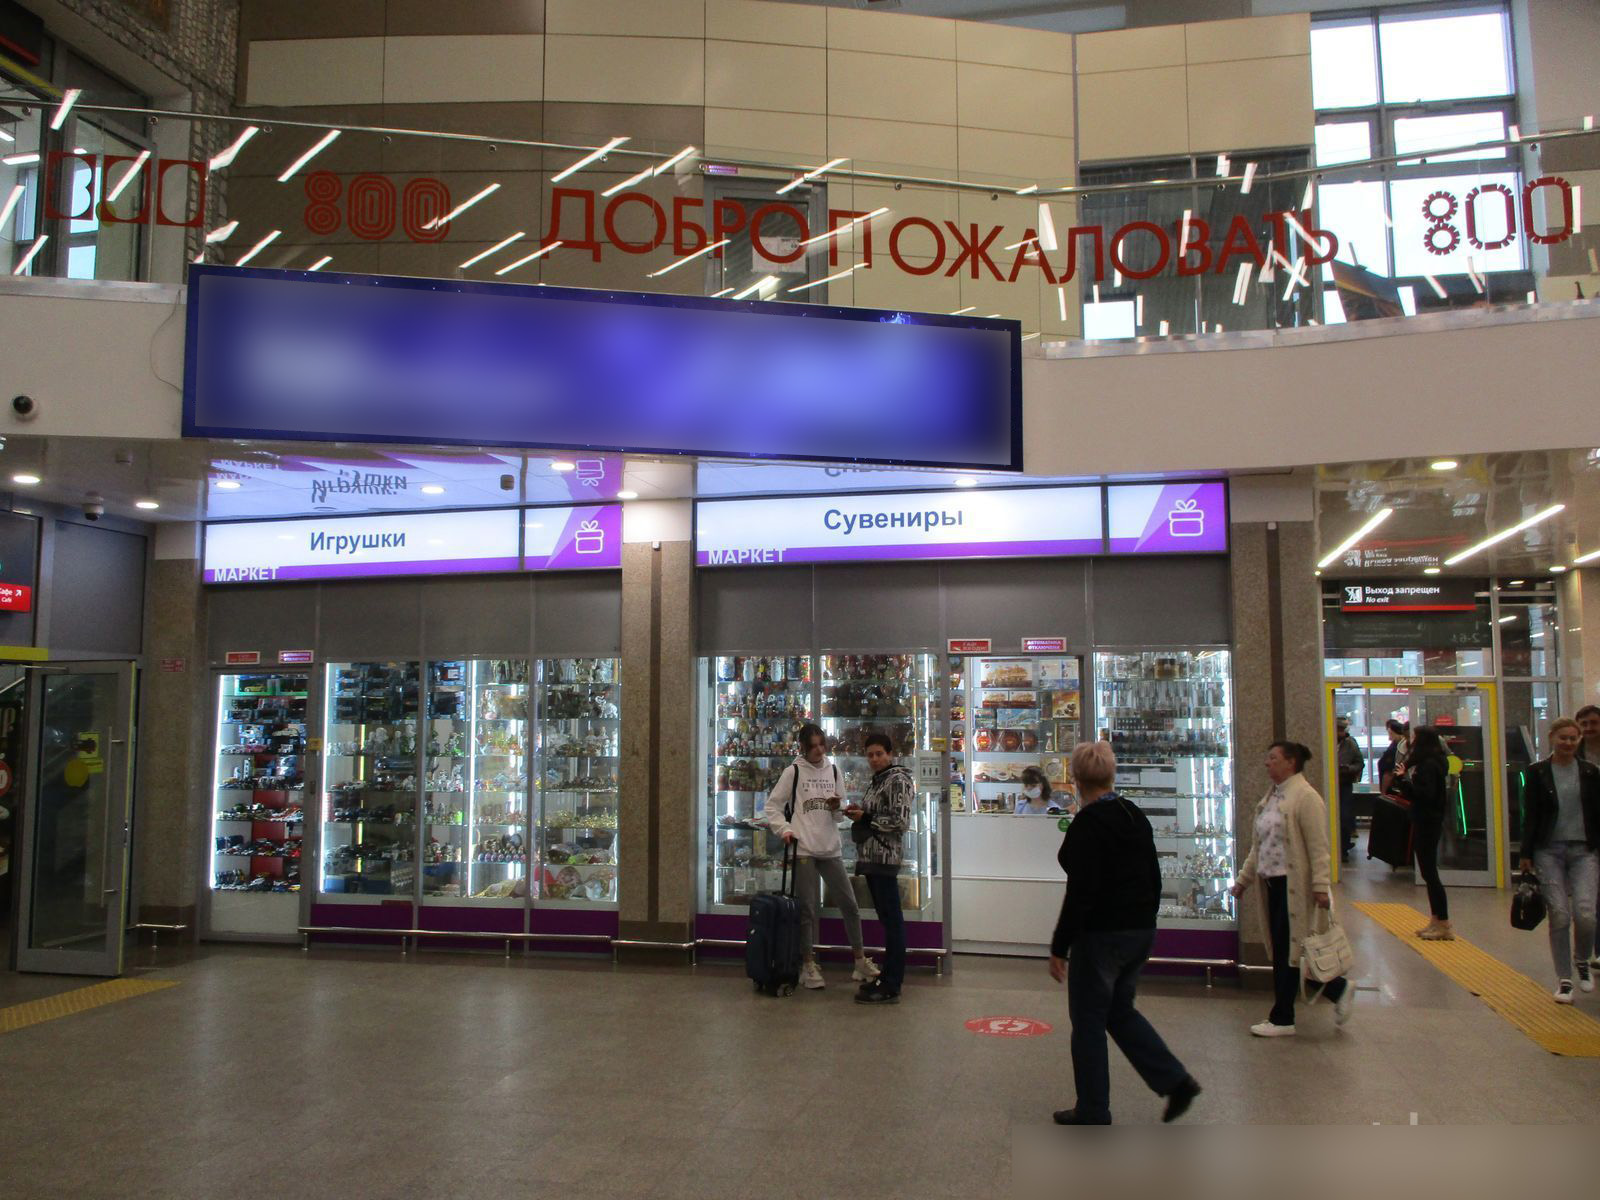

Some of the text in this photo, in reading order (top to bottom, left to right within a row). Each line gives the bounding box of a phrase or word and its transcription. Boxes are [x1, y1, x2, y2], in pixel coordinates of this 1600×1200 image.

[304, 170, 451, 244] 800
[1421, 176, 1573, 256] 800
[540, 187, 1338, 285] ДОБРО ПОЖАЛОВАТЬ
[824, 508, 963, 535] Сувениры
[309, 529, 406, 553] Игрушки
[708, 548, 787, 565] МАРКЕТ
[214, 566, 279, 582] МАРКЕТ
[1365, 586, 1440, 596] Выход запрещен
